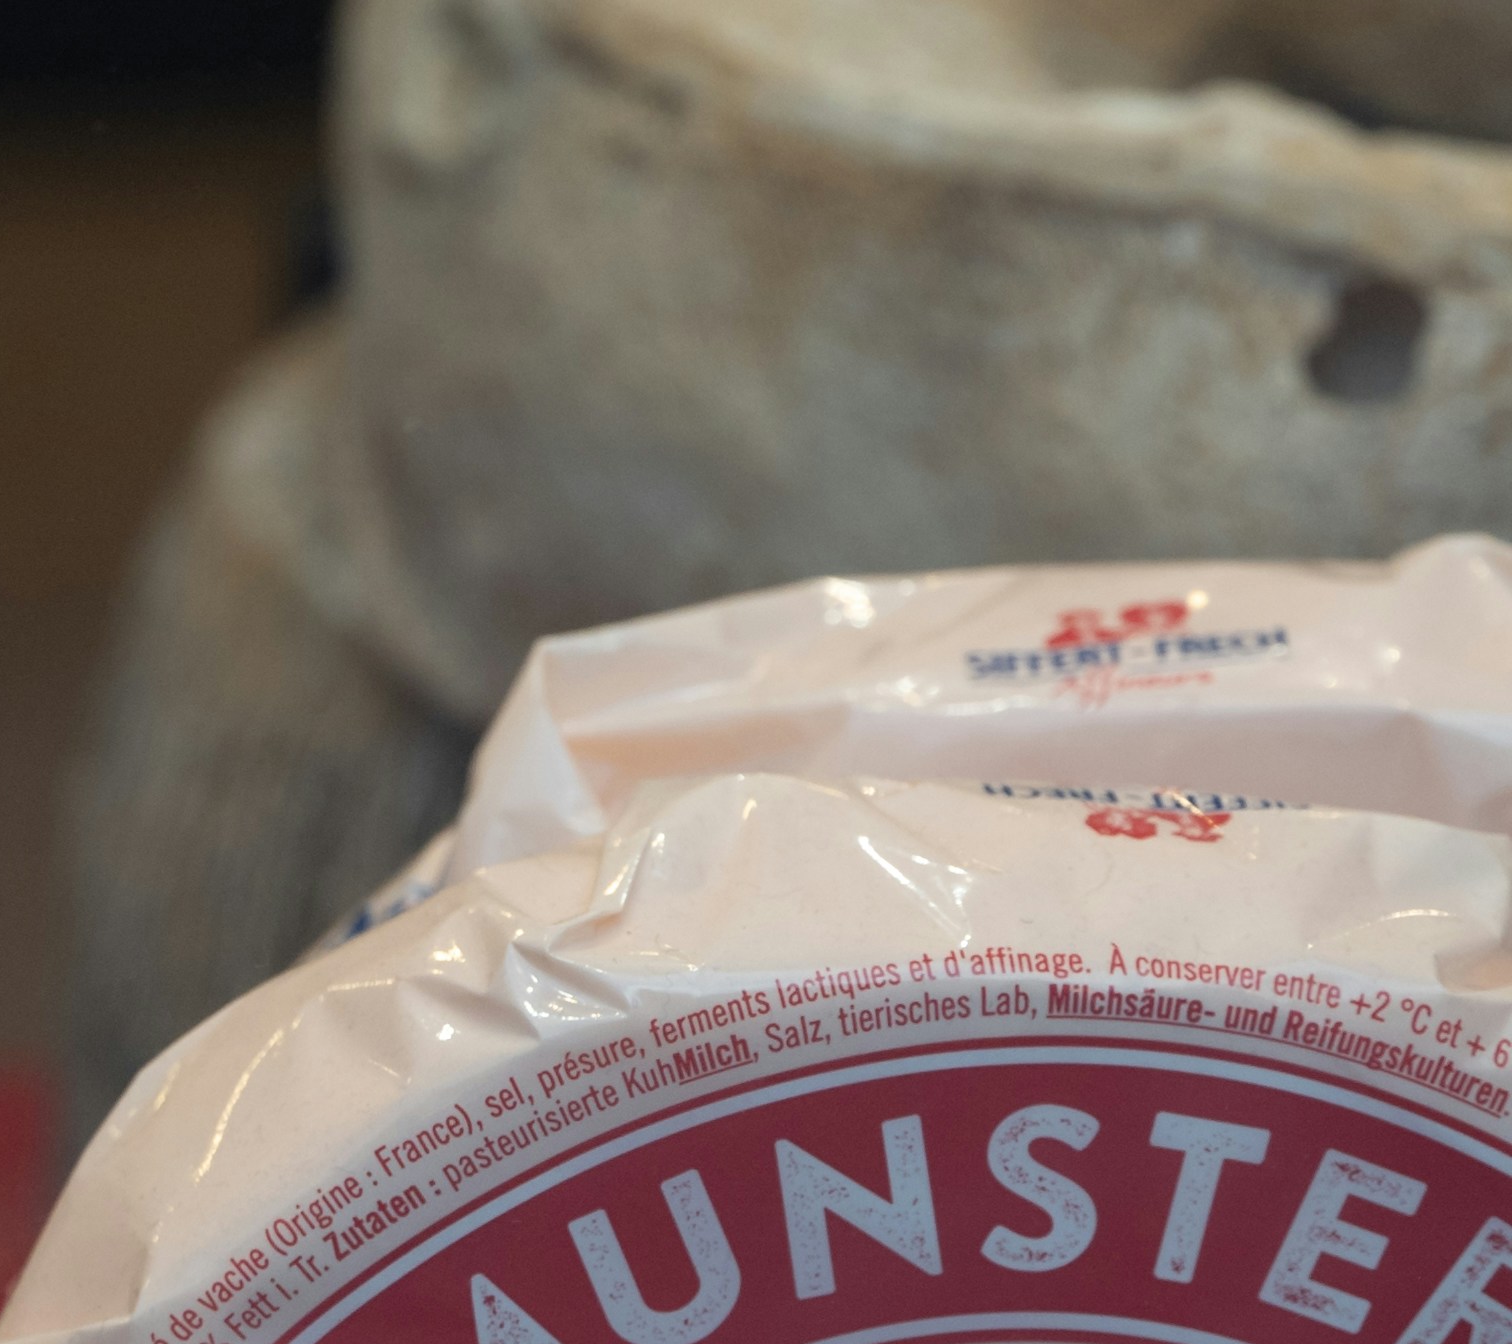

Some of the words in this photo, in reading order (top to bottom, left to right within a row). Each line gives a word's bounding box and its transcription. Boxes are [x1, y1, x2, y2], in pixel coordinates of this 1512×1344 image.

[169, 1307, 204, 1341] de
[197, 1248, 269, 1313] vache
[265, 1175, 364, 1256] (Origine
[373, 1104, 484, 1178] France),
[485, 1076, 535, 1118] sel,
[537, 1036, 646, 1097] présure,
[649, 989, 771, 1047] ferments
[776, 962, 901, 1009] lactiques
[909, 953, 936, 982] et
[944, 947, 1092, 978] d'affinage.
[1109, 942, 1127, 976] À
[1135, 956, 1266, 991] conserver
[1273, 972, 1341, 1008] entre
[1350, 990, 1391, 1022] +2
[1435, 1018, 1462, 1049] et
[224, 1290, 280, 1340] Fett
[290, 1253, 329, 1283] Tr.
[323, 1182, 426, 1261] Zutaten
[442, 1085, 619, 1192] pasteurisierte
[622, 1034, 760, 1099] KuhMilch,
[764, 1015, 831, 1053] Salz,
[838, 991, 971, 1037] tierisches
[981, 985, 1038, 1019] Lab,
[1047, 983, 1216, 1024] Milchsäure-
[1224, 1004, 1277, 1035] und
[1282, 1010, 1512, 1117] Reifungskulturen.
